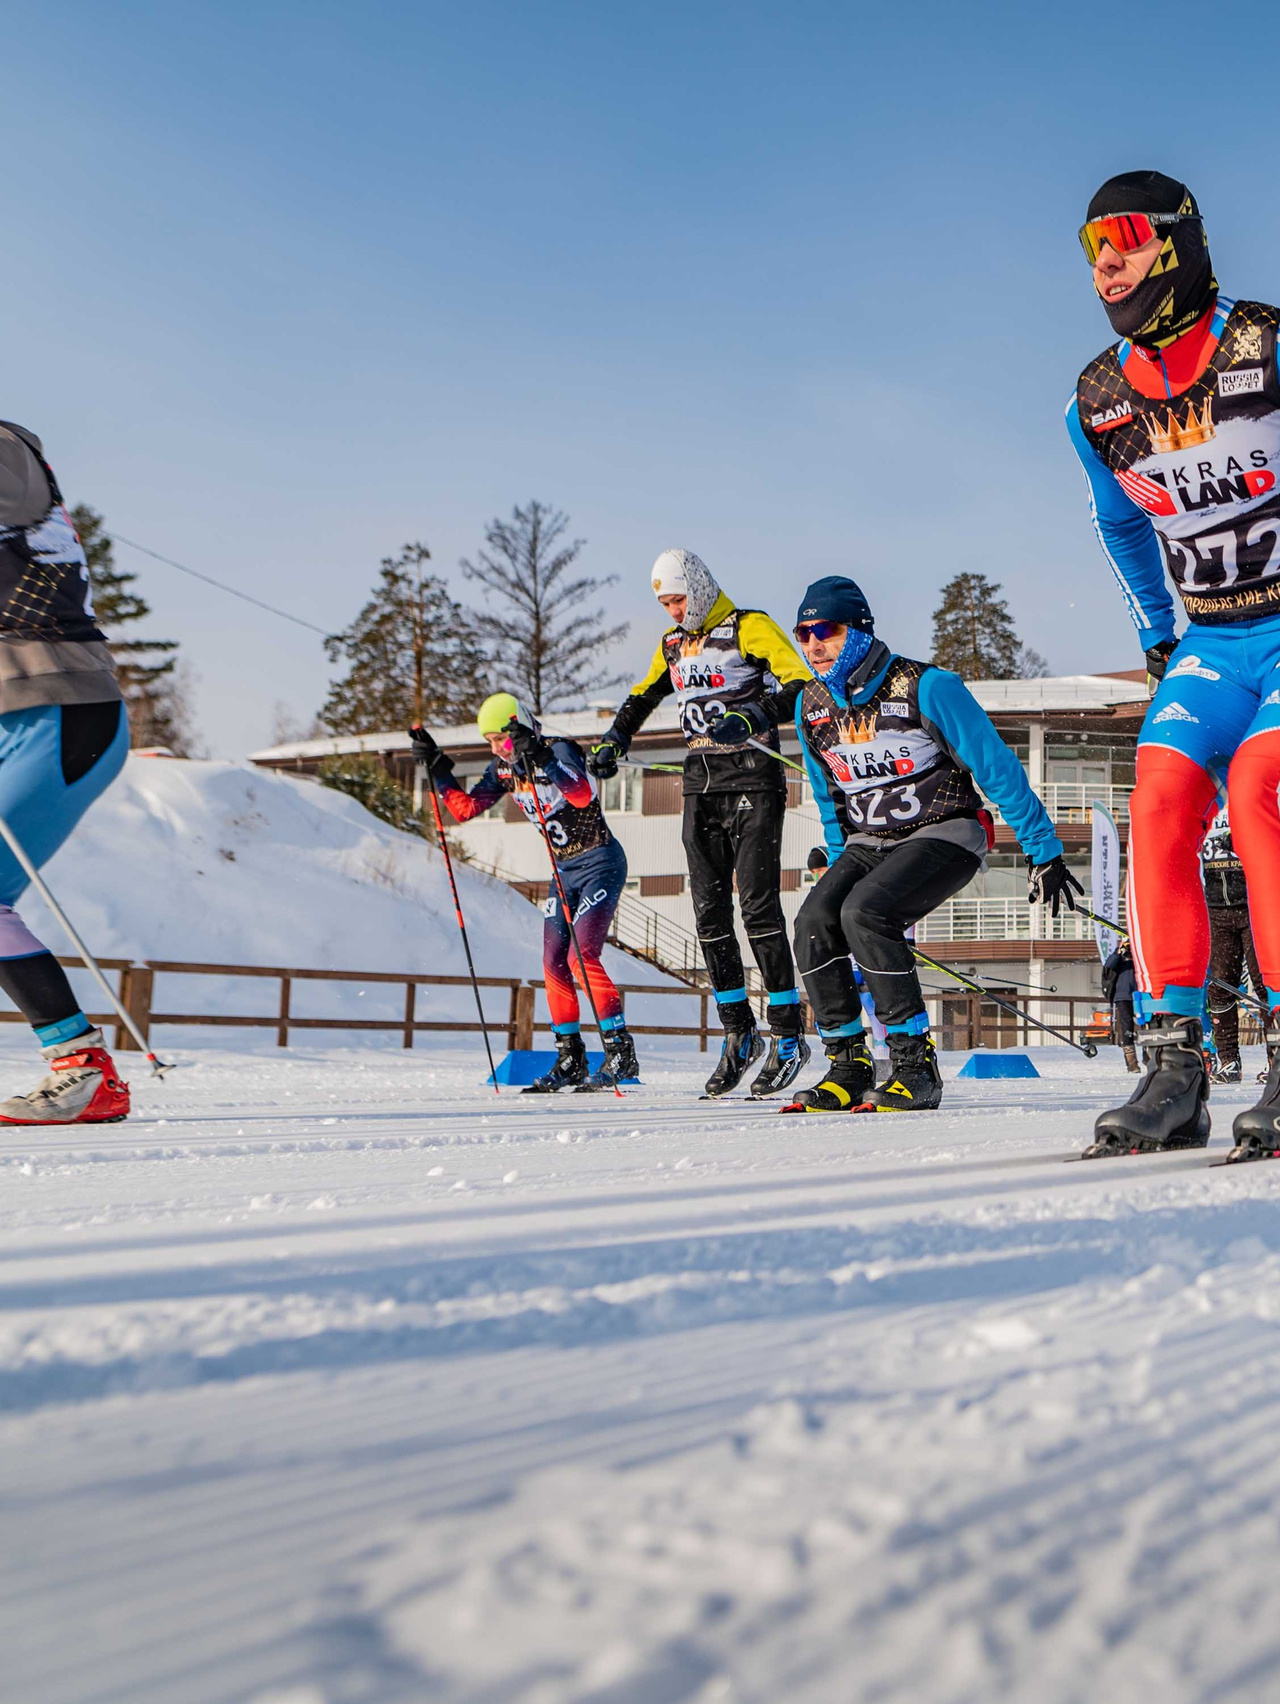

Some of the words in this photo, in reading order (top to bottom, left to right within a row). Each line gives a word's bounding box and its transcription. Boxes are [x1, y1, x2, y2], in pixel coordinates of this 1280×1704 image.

[1171, 449, 1269, 486] KRAS
[1177, 469, 1276, 512] LAND
[681, 664, 723, 675] KRAS
[1152, 713, 1200, 724] adidas
[851, 746, 911, 765] KRAS
[853, 758, 915, 780] LAND
[848, 783, 921, 826] 323
